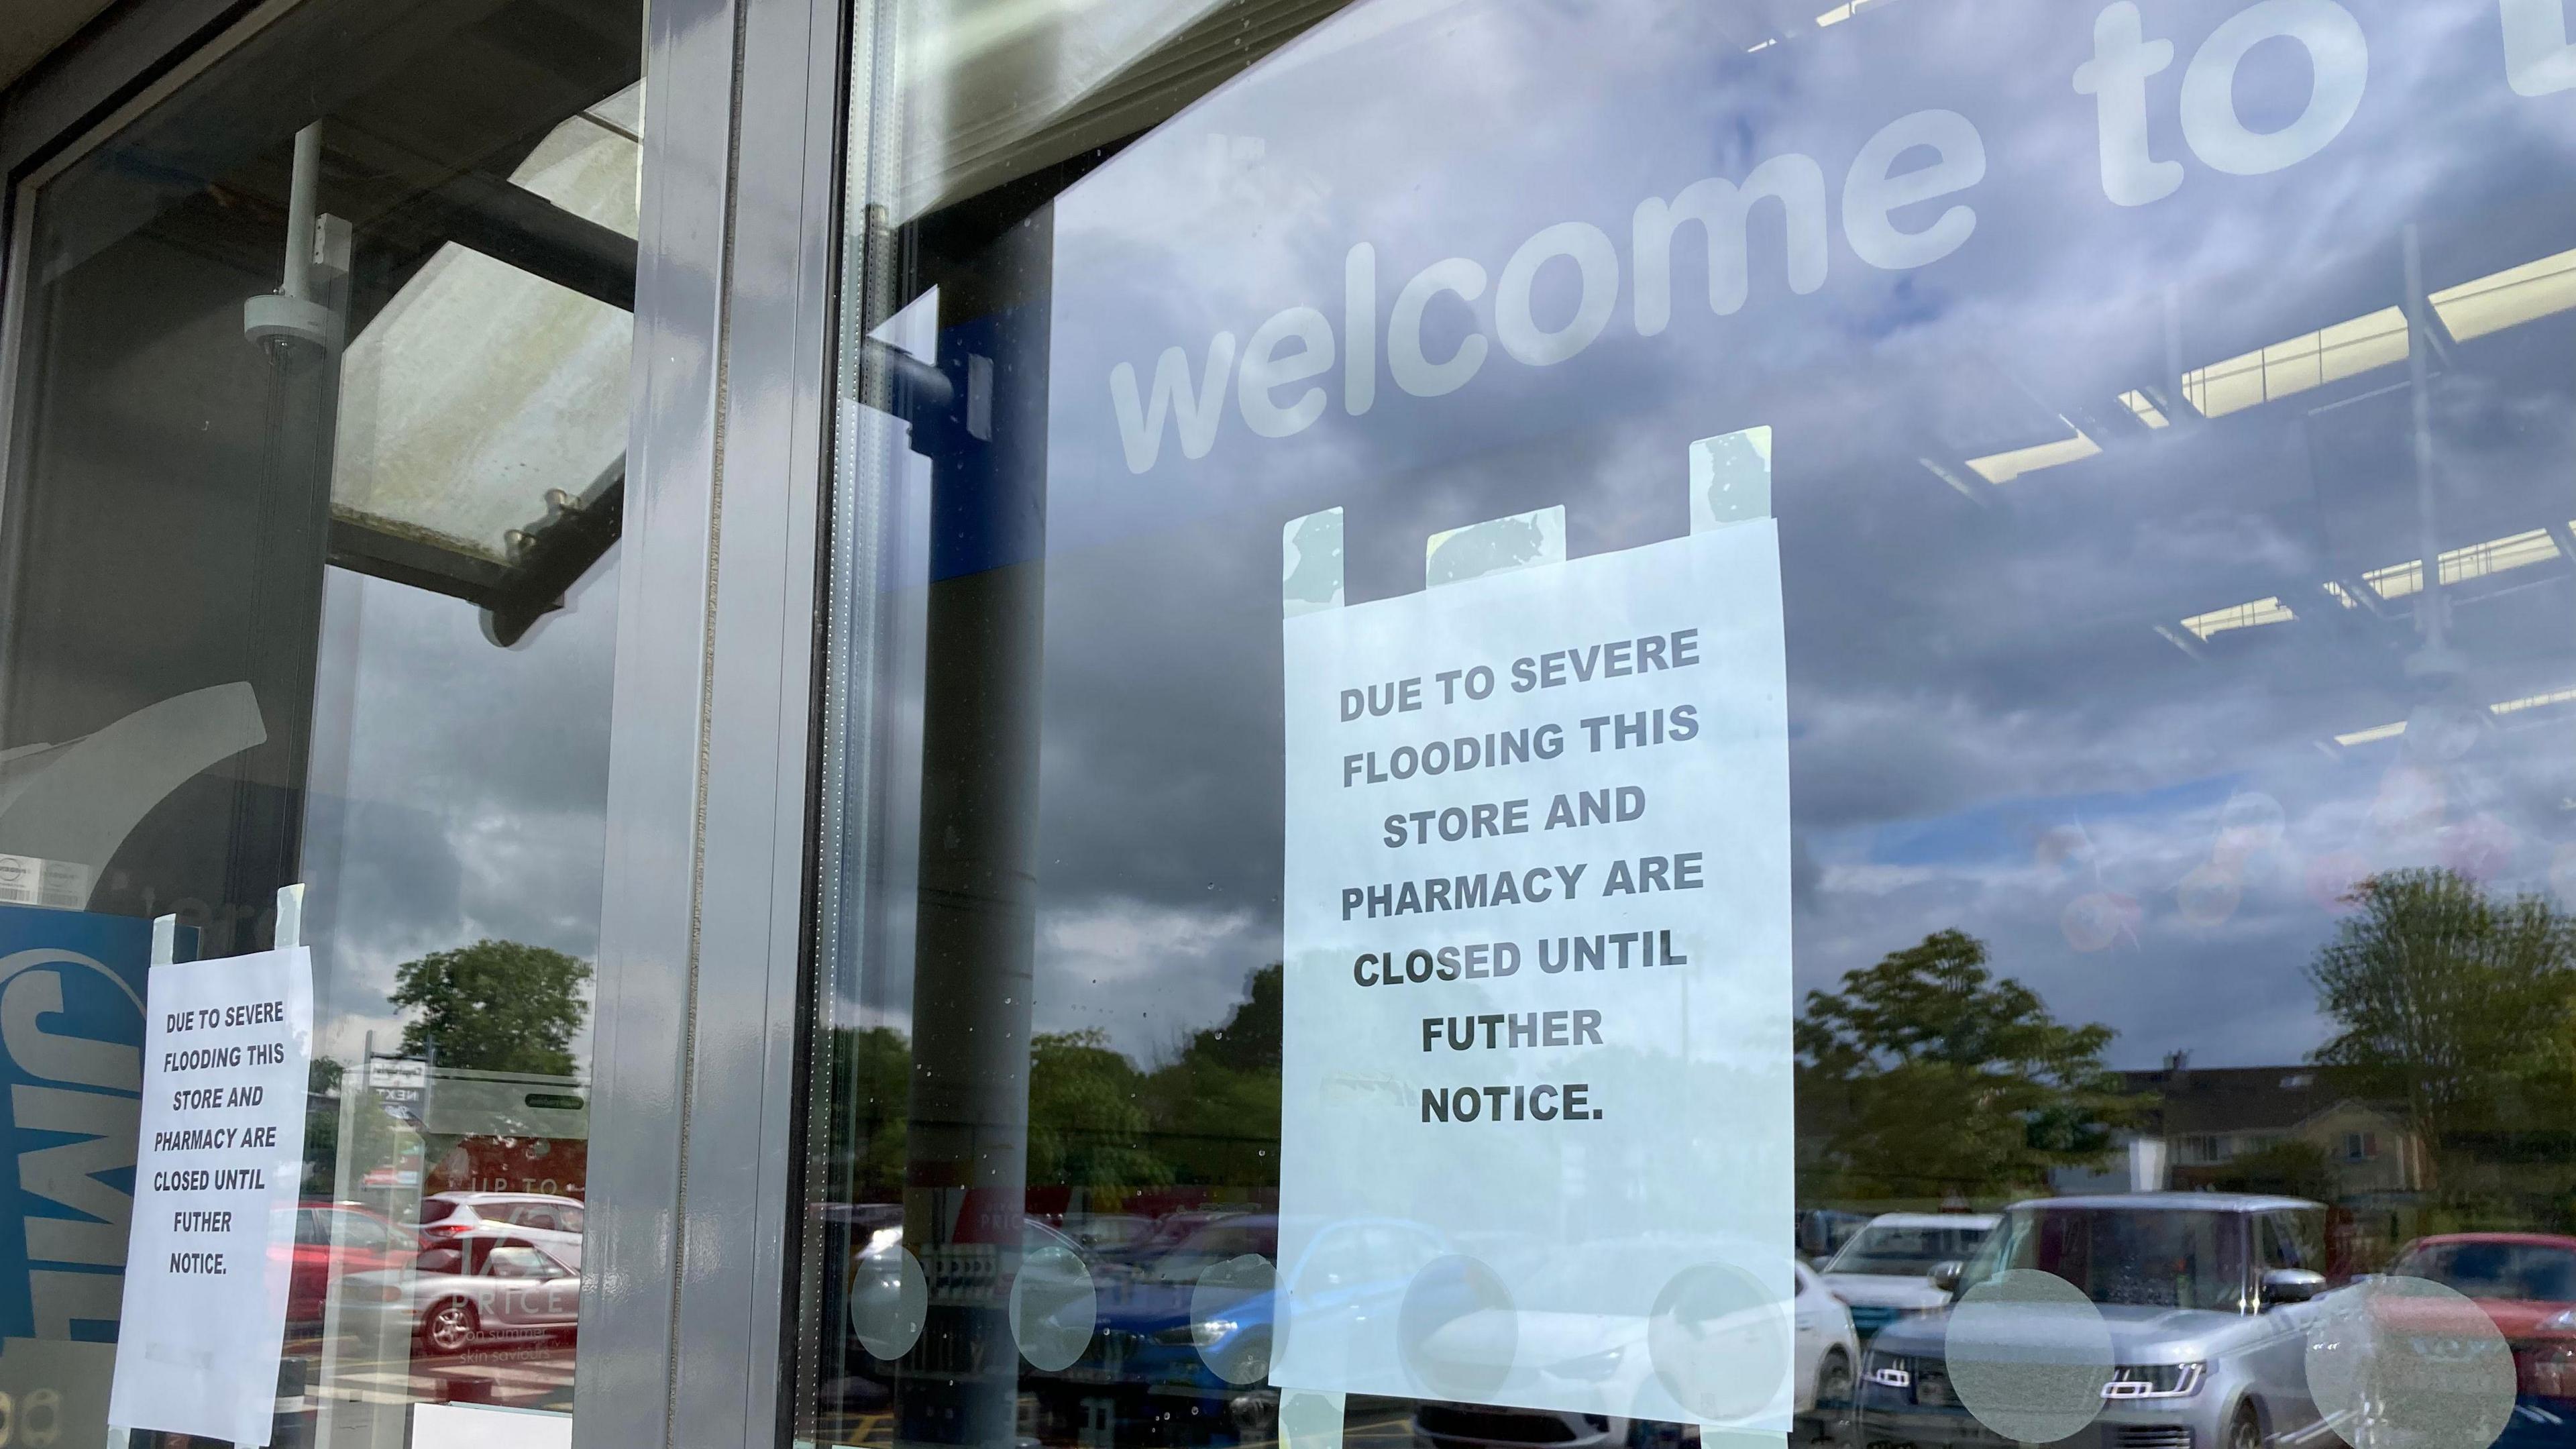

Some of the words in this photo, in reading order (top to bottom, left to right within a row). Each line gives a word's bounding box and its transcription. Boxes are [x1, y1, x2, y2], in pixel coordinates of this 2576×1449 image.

[1108, 108, 1987, 474] welcome
[2072, 0, 2369, 206] to
[1340, 677, 1422, 722] DUE
[1436, 665, 1495, 705] TO
[1511, 628, 1699, 693] SEVERE
[1344, 724, 1564, 788] FLOODING
[1580, 704, 1699, 753] THIS
[1383, 798, 1529, 848] STORE
[1544, 786, 1646, 830] AND
[1342, 863, 1588, 921] PHARMACY
[1602, 852, 1703, 896] ARE
[1354, 942, 1521, 987] CLOSED
[1539, 929, 1687, 973] UNTIL
[167, 1012, 194, 1033] DUE
[199, 1009, 220, 1029] TO
[225, 1001, 283, 1026] SEVERE
[1423, 1010, 1603, 1052] FUTHER
[164, 1046, 241, 1072] FLOODING
[247, 1043, 284, 1065] THIS
[173, 1088, 223, 1111] STORE
[227, 1086, 263, 1108] AND
[1422, 1083, 1603, 1122] NOTICE.
[154, 1128, 238, 1151] PHARMACY
[240, 1127, 276, 1148] ARE
[154, 1171, 209, 1191] CLOSED
[215, 1169, 265, 1190] UNTIL
[523, 1177, 558, 1193] TO
[174, 1212, 231, 1232] FUTHER
[170, 1253, 226, 1274] NOTICE.
[452, 1289, 564, 1315] PRICE
[466, 1330, 484, 1342] on
[489, 1328, 547, 1340] summer
[460, 1347, 488, 1364] skin
[492, 1346, 550, 1362] saviours
